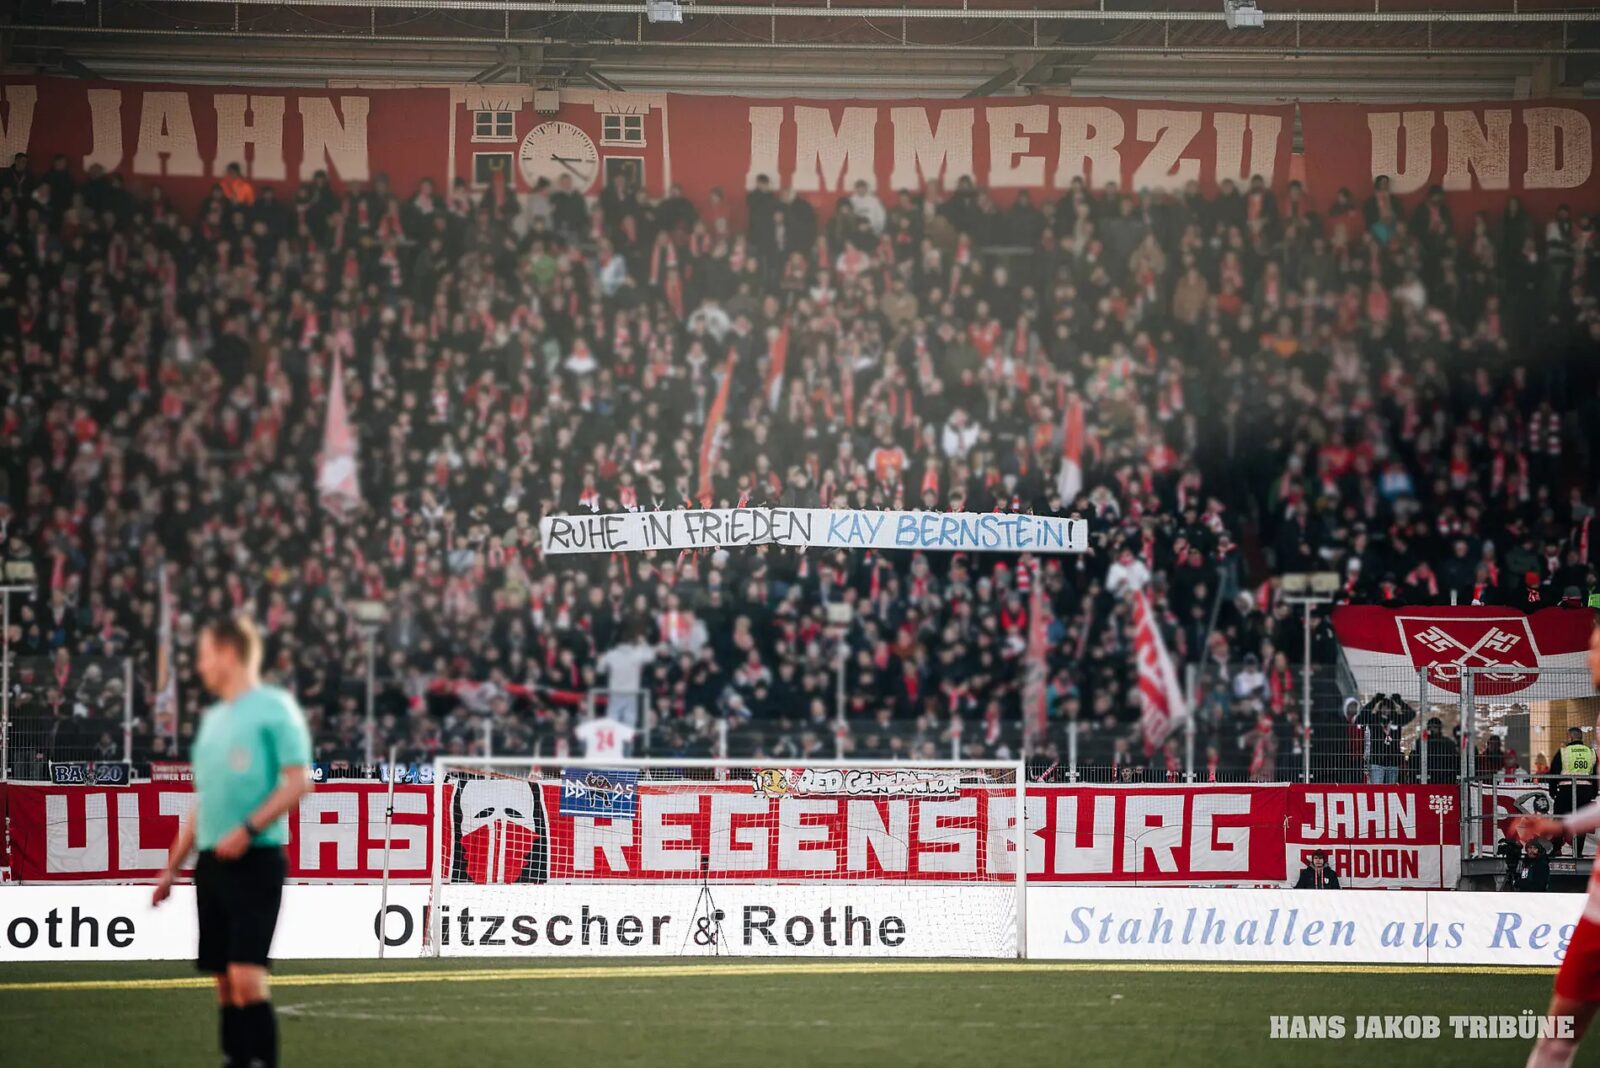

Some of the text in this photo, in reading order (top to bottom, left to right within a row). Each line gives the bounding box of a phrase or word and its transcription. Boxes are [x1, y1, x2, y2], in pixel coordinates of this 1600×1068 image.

[84, 88, 370, 181] JAHN
[746, 104, 1592, 194] IMMERZU UND
[548, 516, 627, 549] RUHE
[827, 512, 885, 545] KAY
[596, 730, 614, 752] 24
[55, 765, 122, 782] BA 20
[799, 769, 844, 795] RED
[1574, 760, 1588, 769] 680
[45, 791, 1252, 874] ULTAS REGENSBURG
[1301, 792, 1417, 839] JAHN
[0, 906, 135, 948] othe
[743, 904, 906, 947] Rothe
[1064, 905, 1356, 947] Stahlhallen
[1380, 919, 1465, 949] aus
